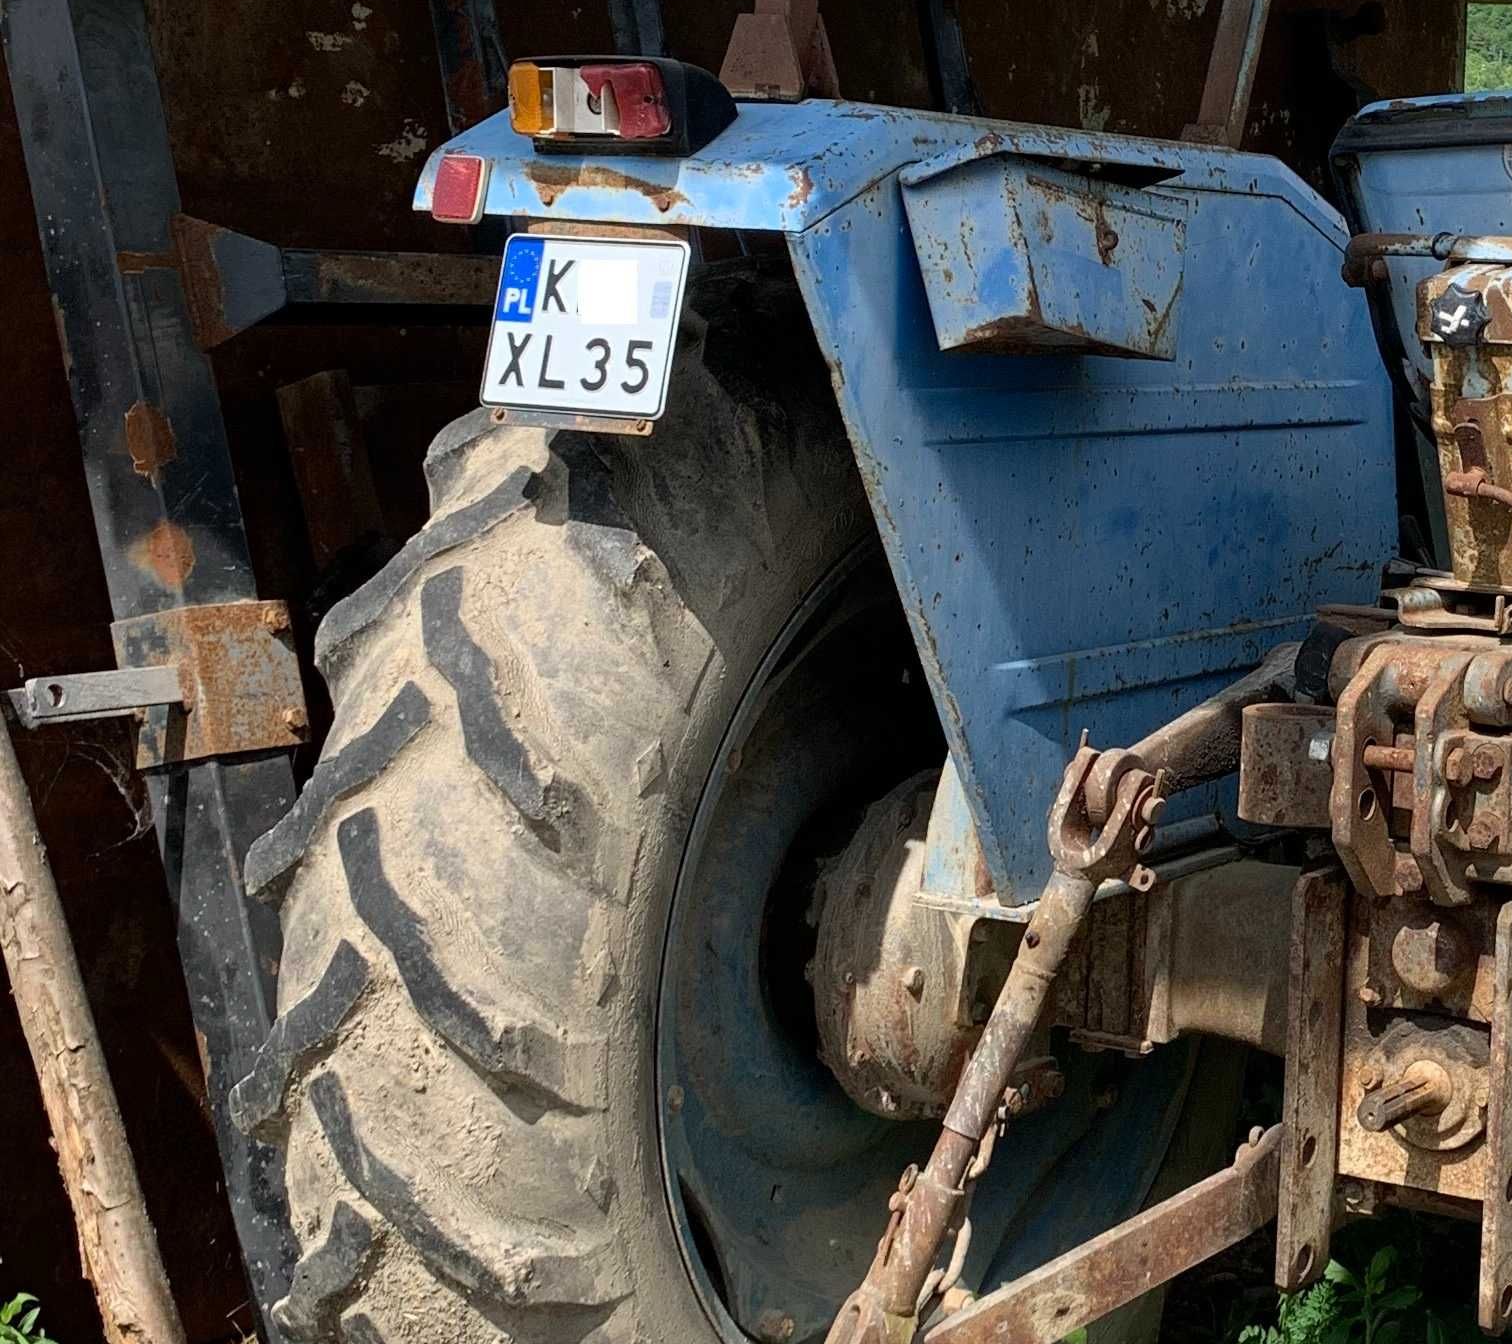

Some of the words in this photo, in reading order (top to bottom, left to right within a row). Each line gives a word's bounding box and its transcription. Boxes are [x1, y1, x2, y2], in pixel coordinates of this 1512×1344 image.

[503, 287, 532, 315] PL
[541, 258, 578, 313] K
[498, 331, 654, 395] XL35
